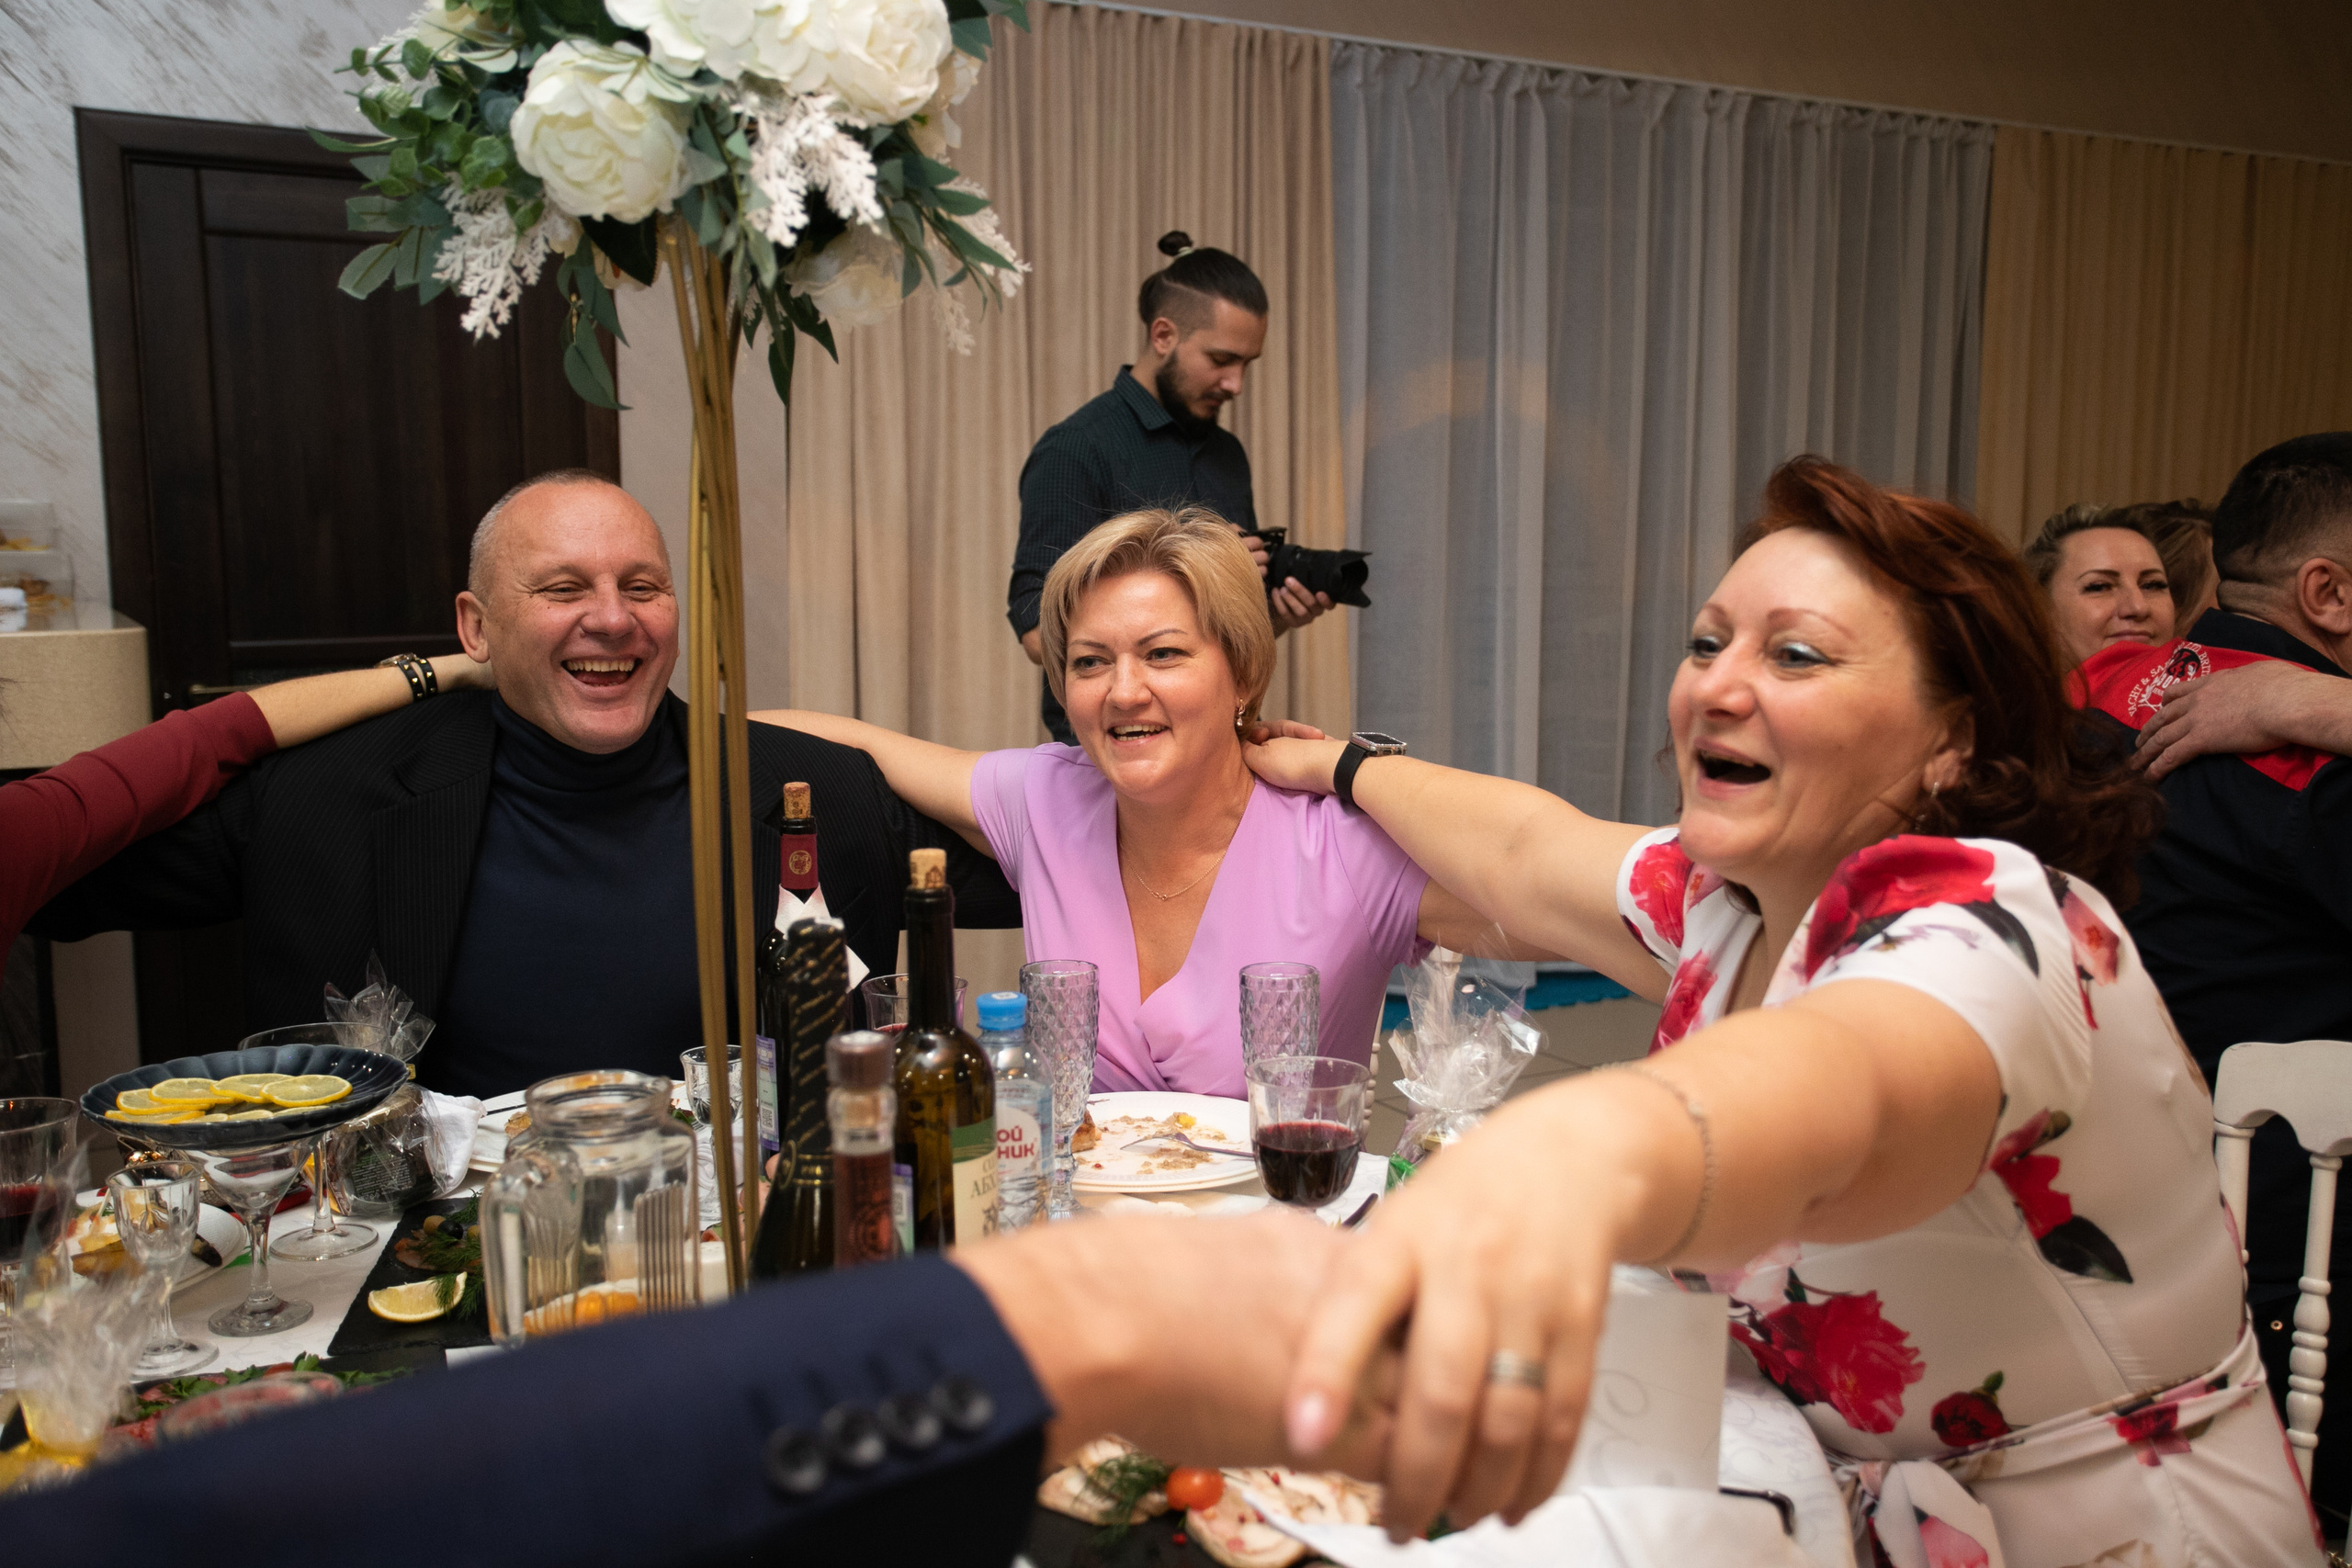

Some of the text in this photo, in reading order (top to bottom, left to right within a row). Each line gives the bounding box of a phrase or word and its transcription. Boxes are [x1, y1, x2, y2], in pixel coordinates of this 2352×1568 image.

[2127, 683, 2143, 717] YACHT
[2141, 677, 2150, 685] &
[2199, 651, 2211, 677] BRIT
[997, 1143, 1035, 1159] ник
